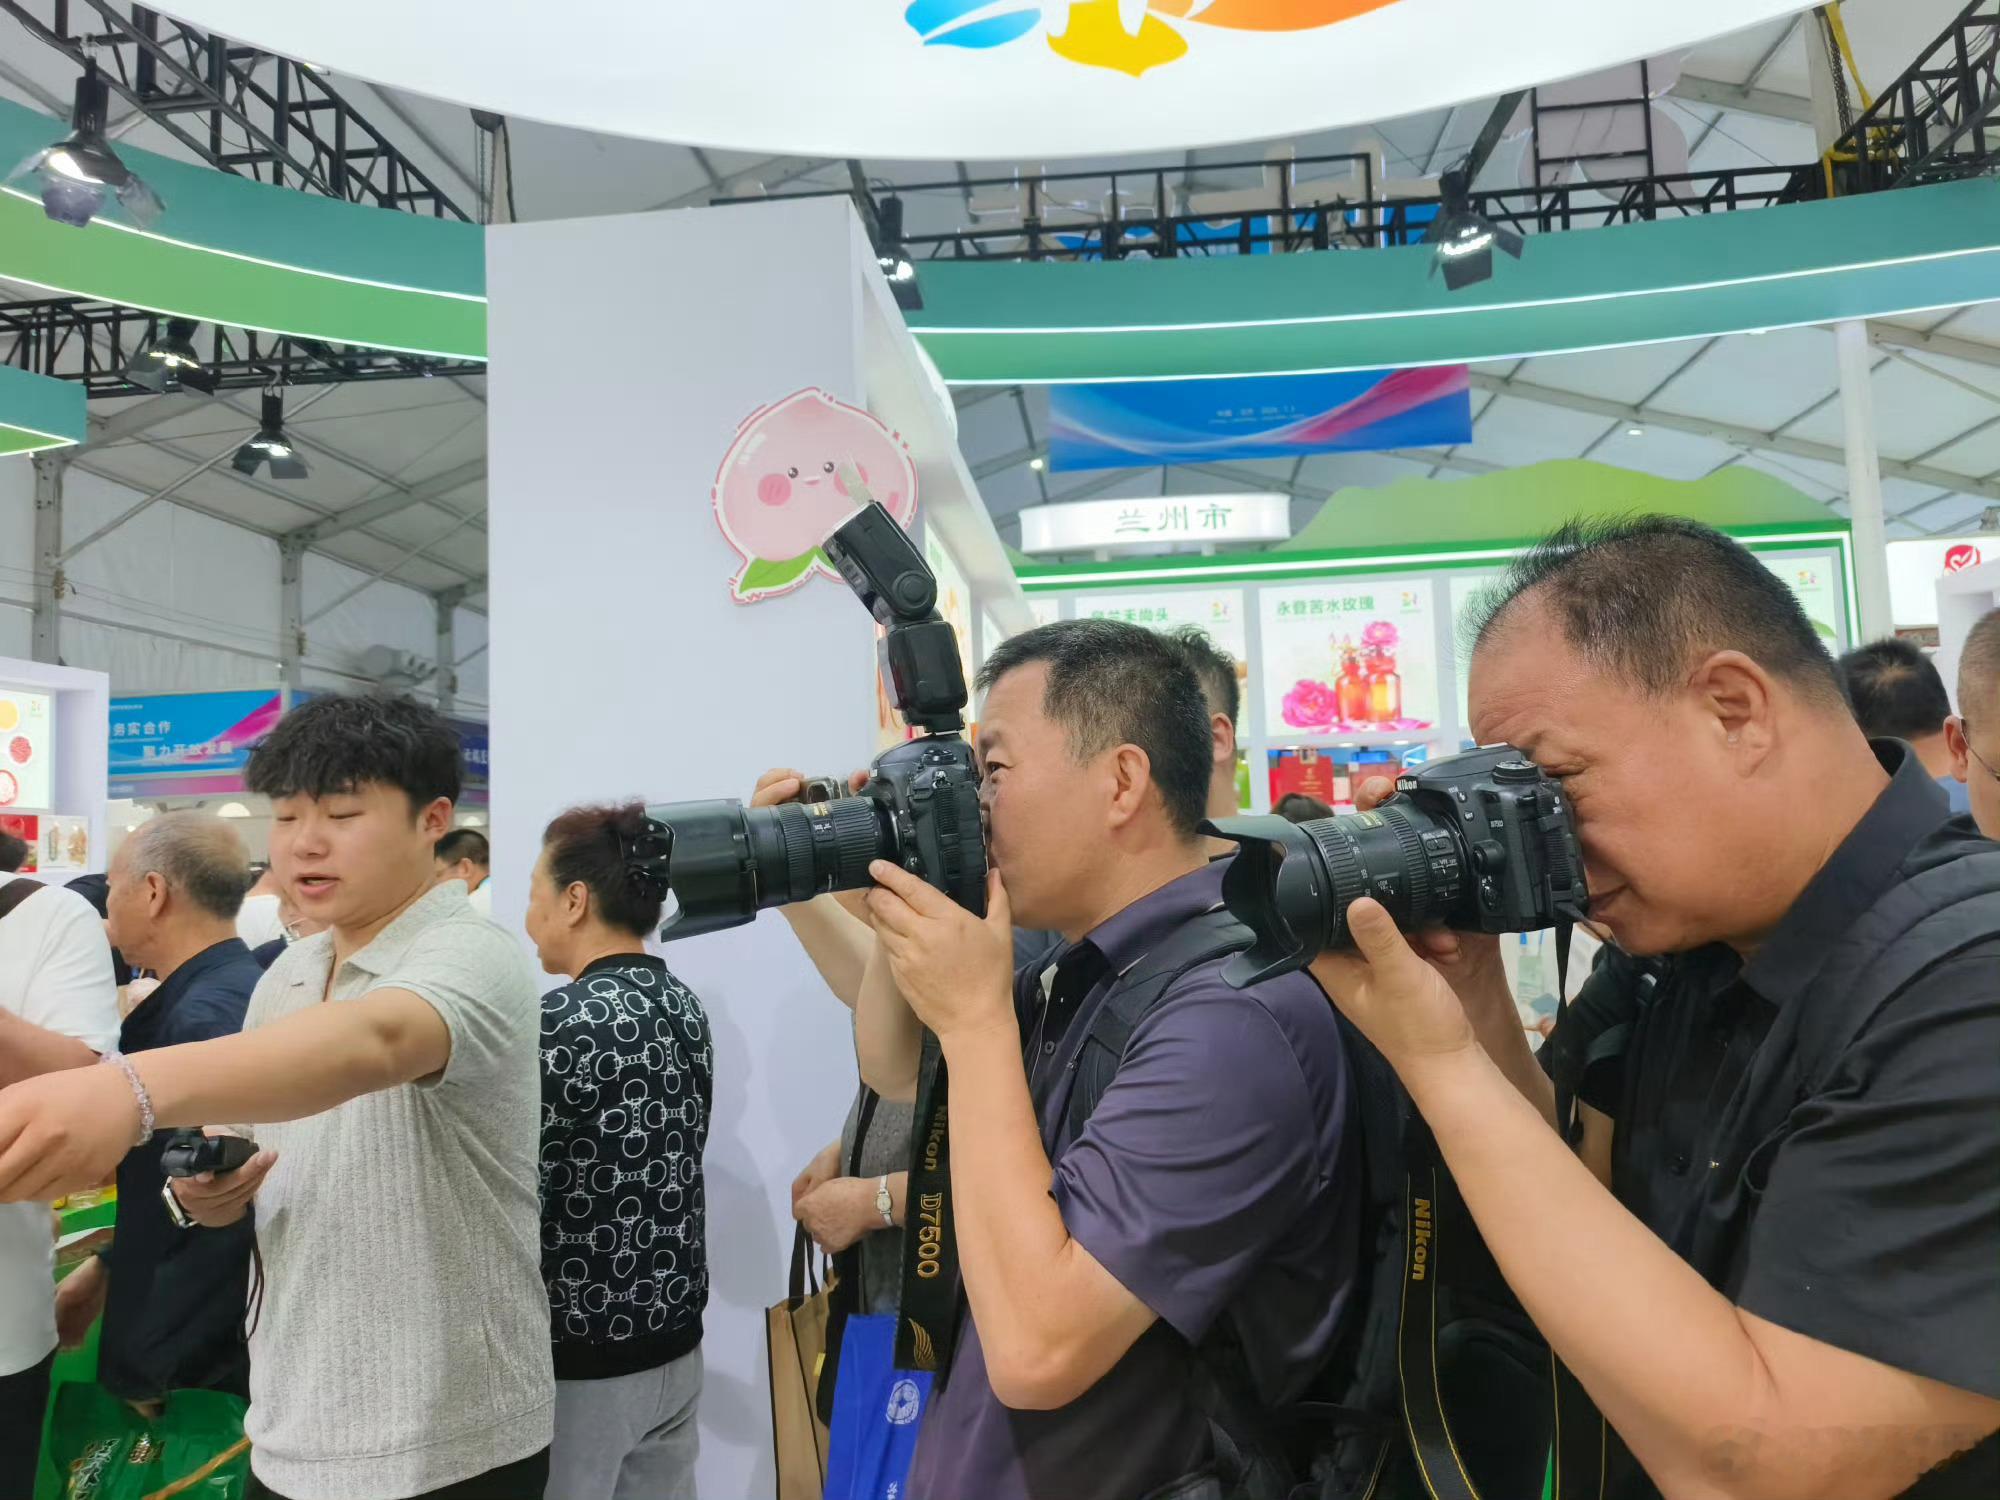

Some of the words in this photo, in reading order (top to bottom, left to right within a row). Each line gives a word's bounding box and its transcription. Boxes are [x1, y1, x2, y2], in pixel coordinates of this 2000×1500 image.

[1115, 503, 1233, 533] 兰州市
[1279, 596, 1374, 616] 永登苦水玫瑰
[1396, 779, 1418, 791] Nikon
[925, 1104, 948, 1171] Nikon
[917, 1192, 943, 1279] D7500
[1412, 1198, 1431, 1281] Nikon
